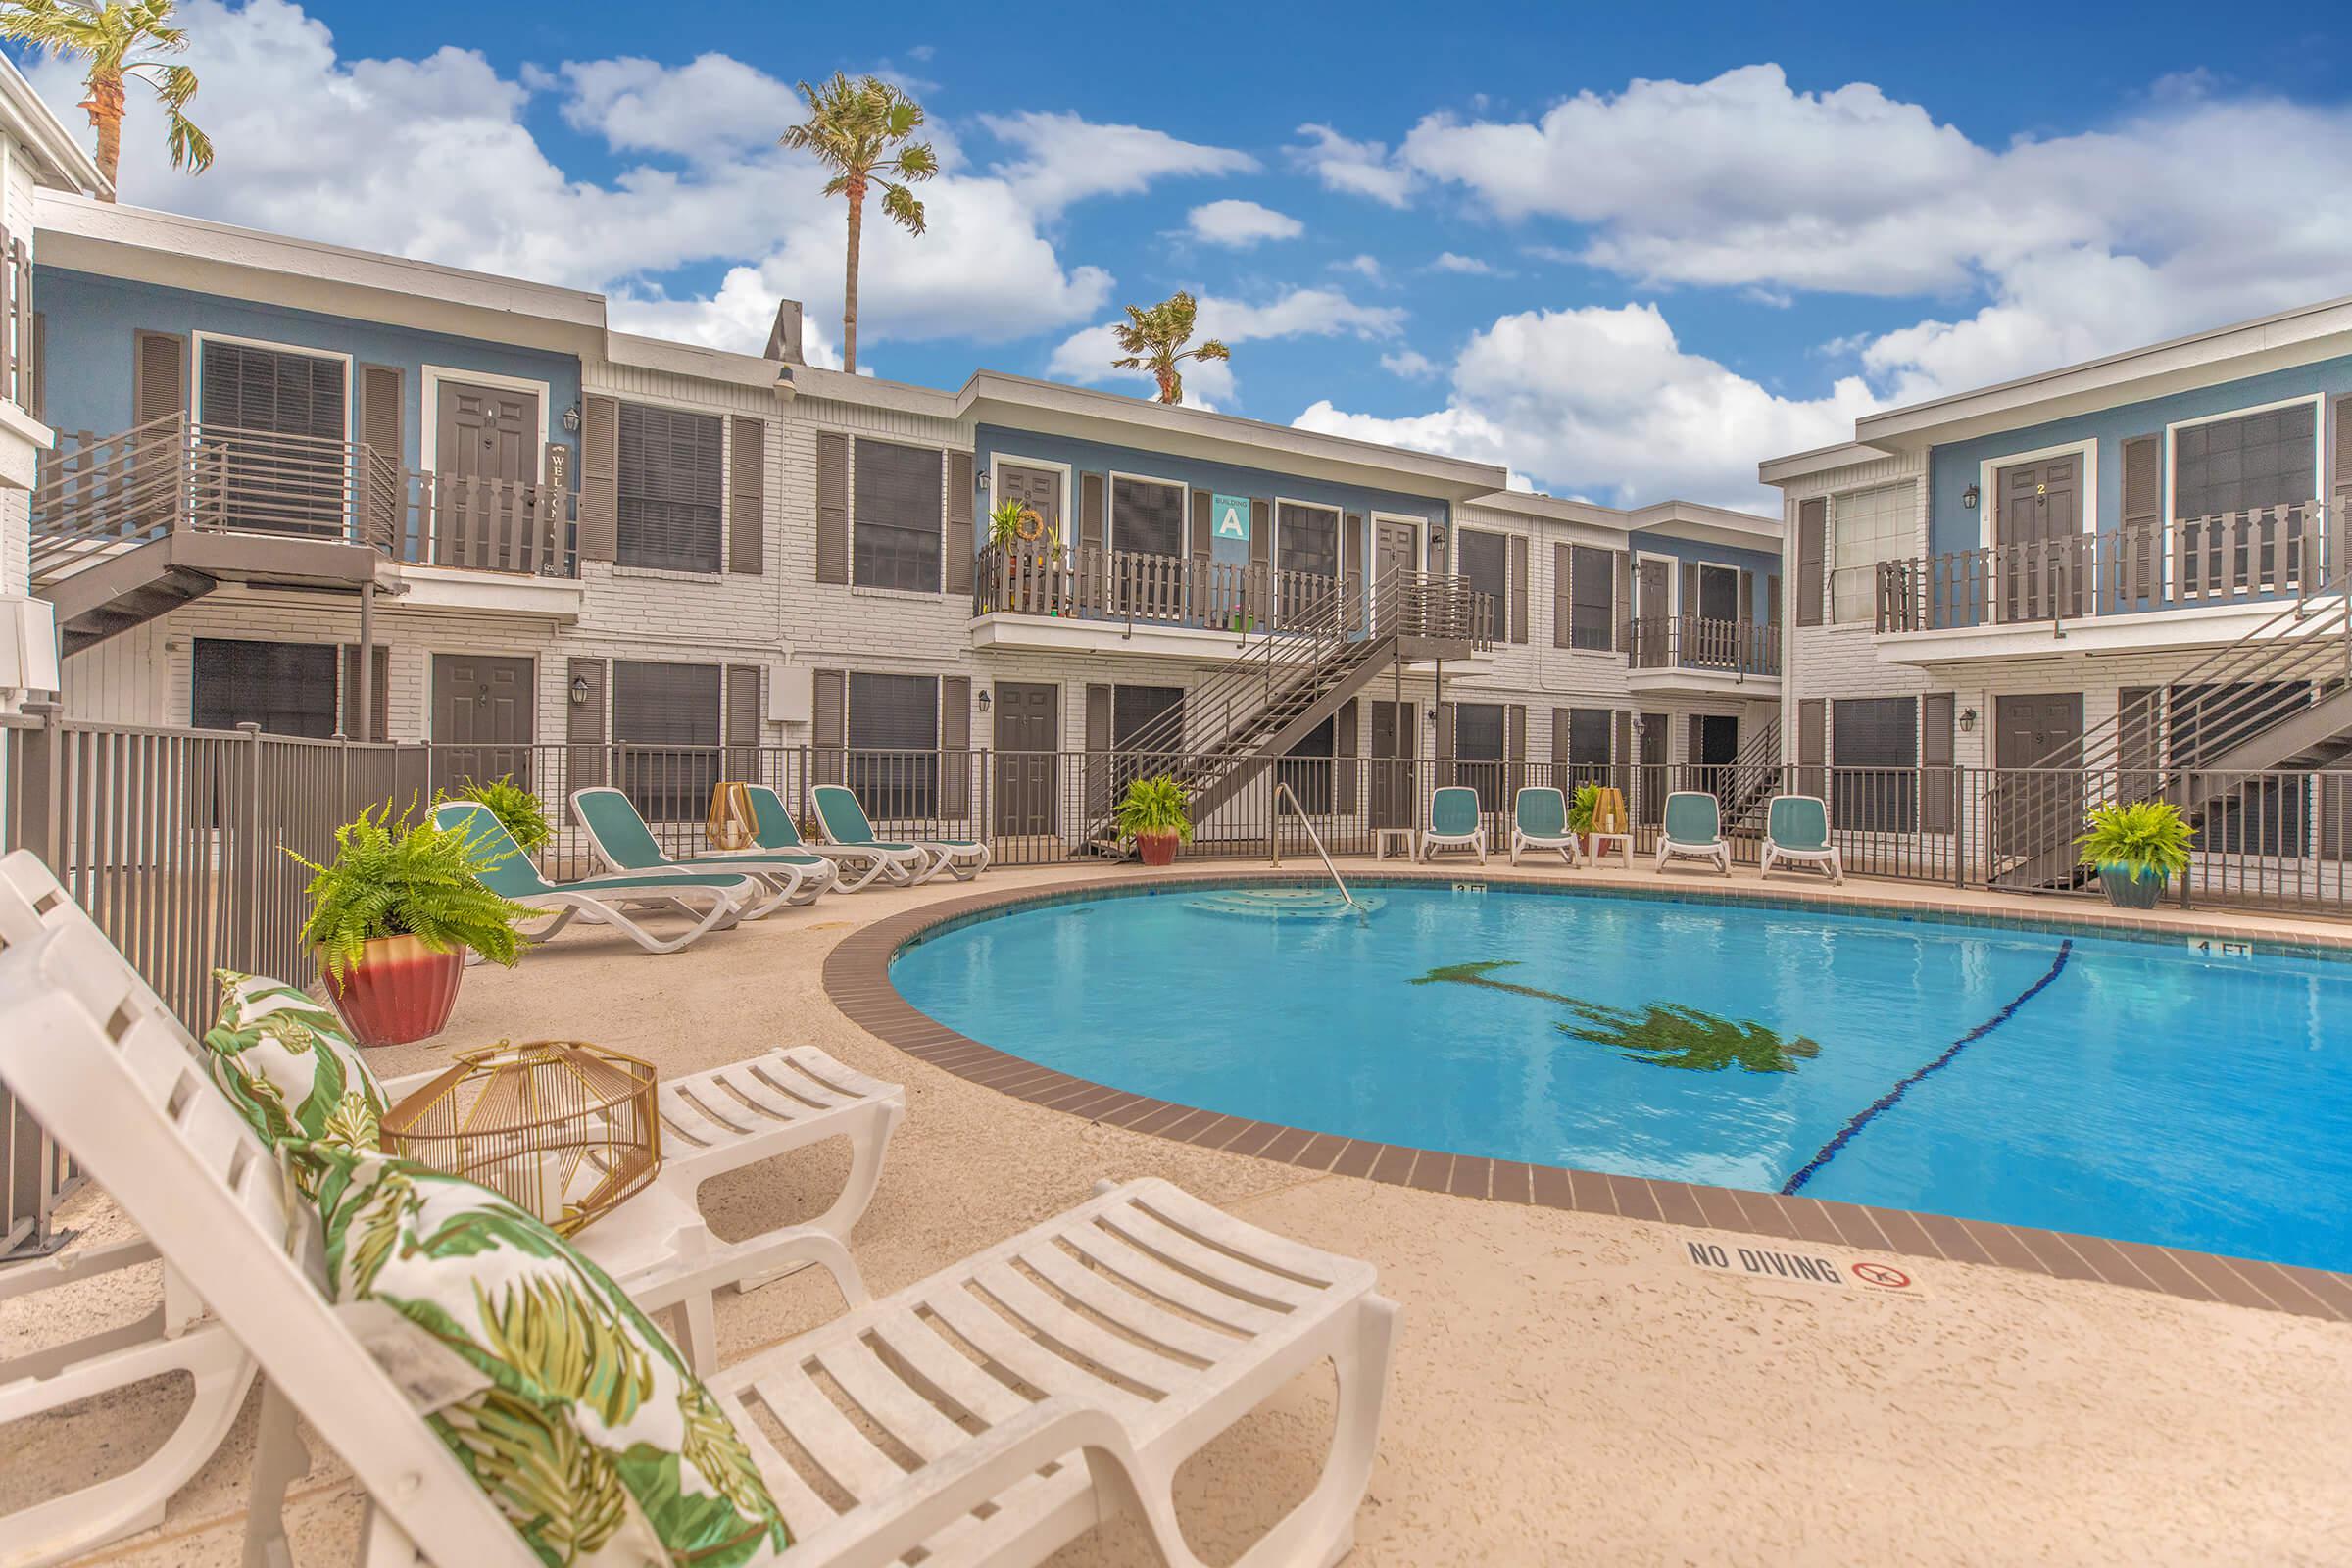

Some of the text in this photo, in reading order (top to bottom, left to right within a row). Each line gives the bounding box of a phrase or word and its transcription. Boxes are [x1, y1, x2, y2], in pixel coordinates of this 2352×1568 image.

[1024, 490, 1032, 500] 8
[2037, 484, 2046, 495] 2
[1219, 508, 1244, 536] A
[2196, 941, 2249, 955] 4 FT
[1687, 1241, 1842, 1284] NO DIVING
